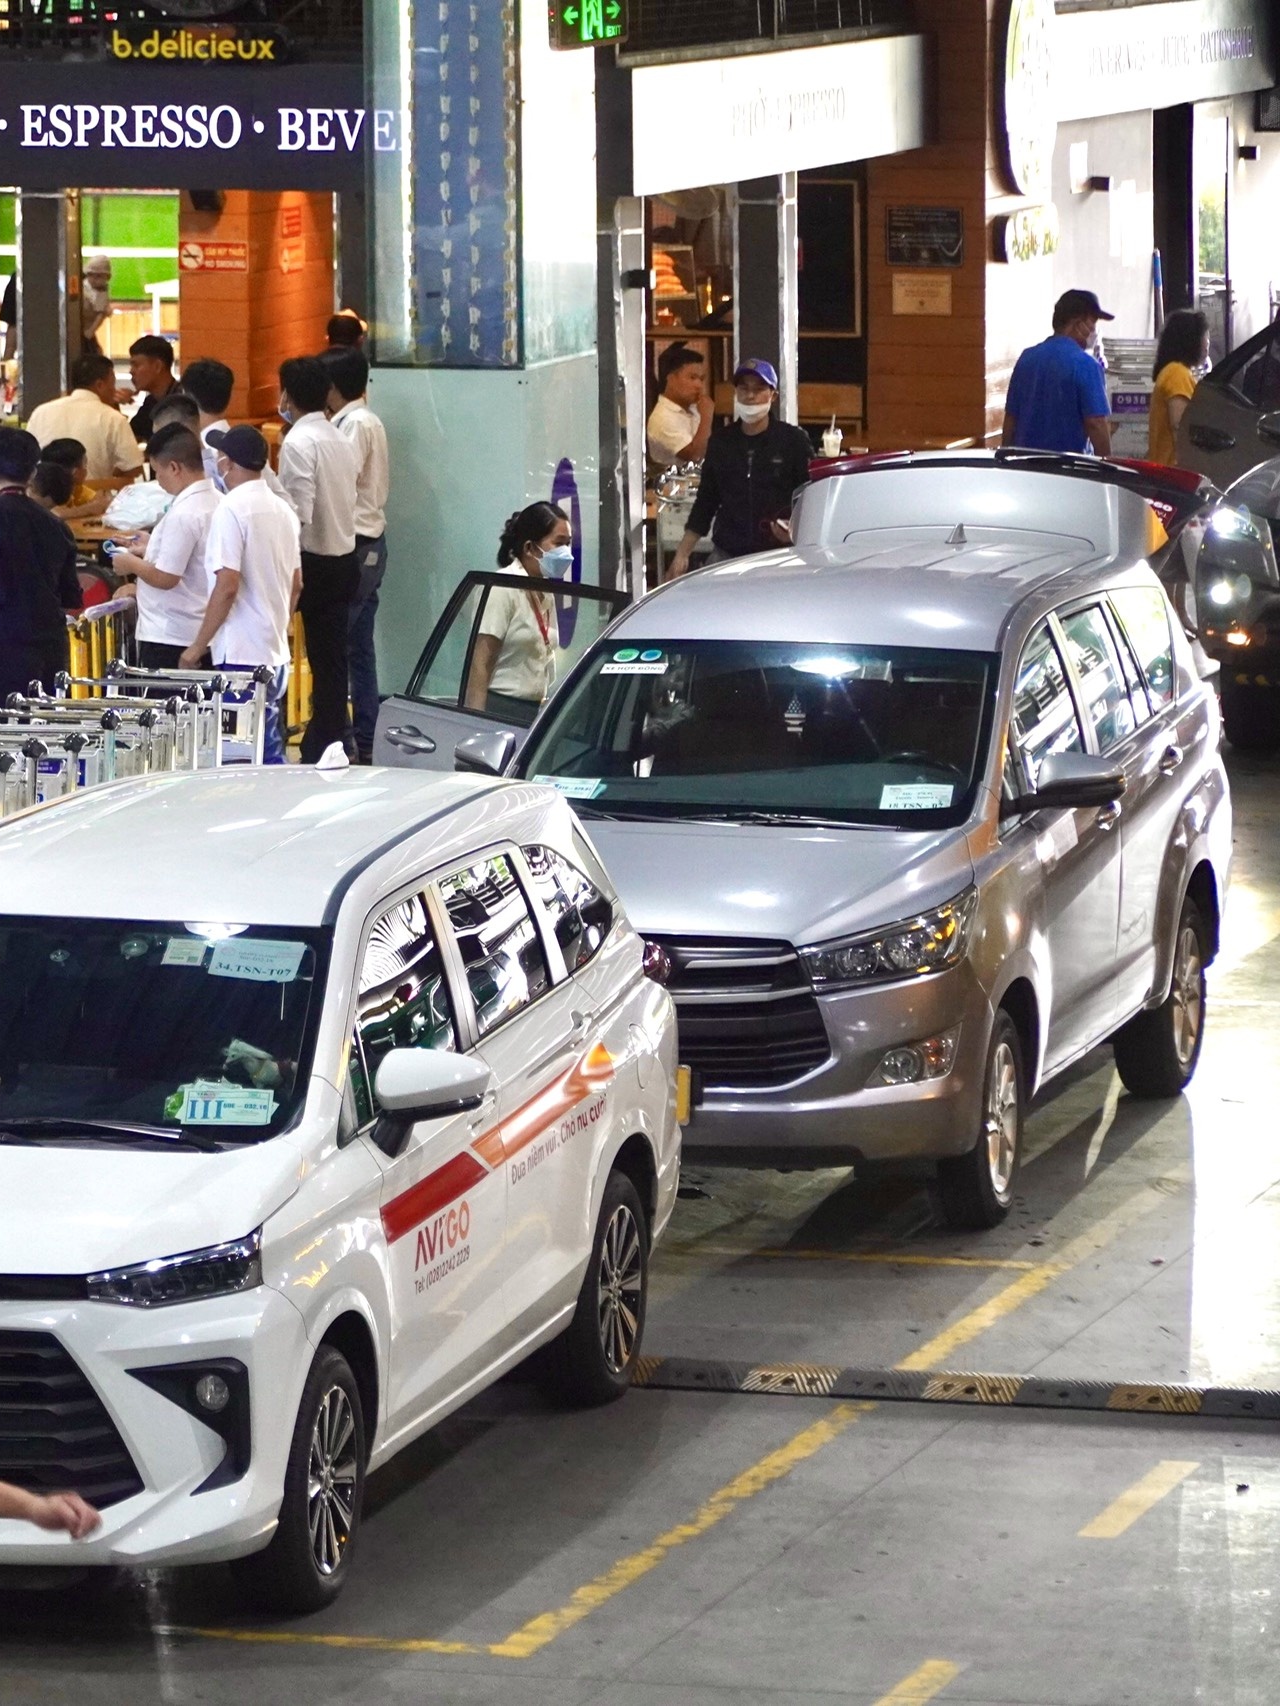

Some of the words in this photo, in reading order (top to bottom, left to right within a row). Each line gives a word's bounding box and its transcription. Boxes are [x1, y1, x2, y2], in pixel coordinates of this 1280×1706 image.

[606, 25, 622, 37] EXIT
[112, 32, 275, 60] b.délicieux
[20, 104, 243, 149] ESPRESSO
[214, 961, 292, 977] 34.TSN-T07
[187, 1099, 224, 1120] III
[577, 1113, 588, 1132] nụ
[456, 1244, 470, 1268] 2229
